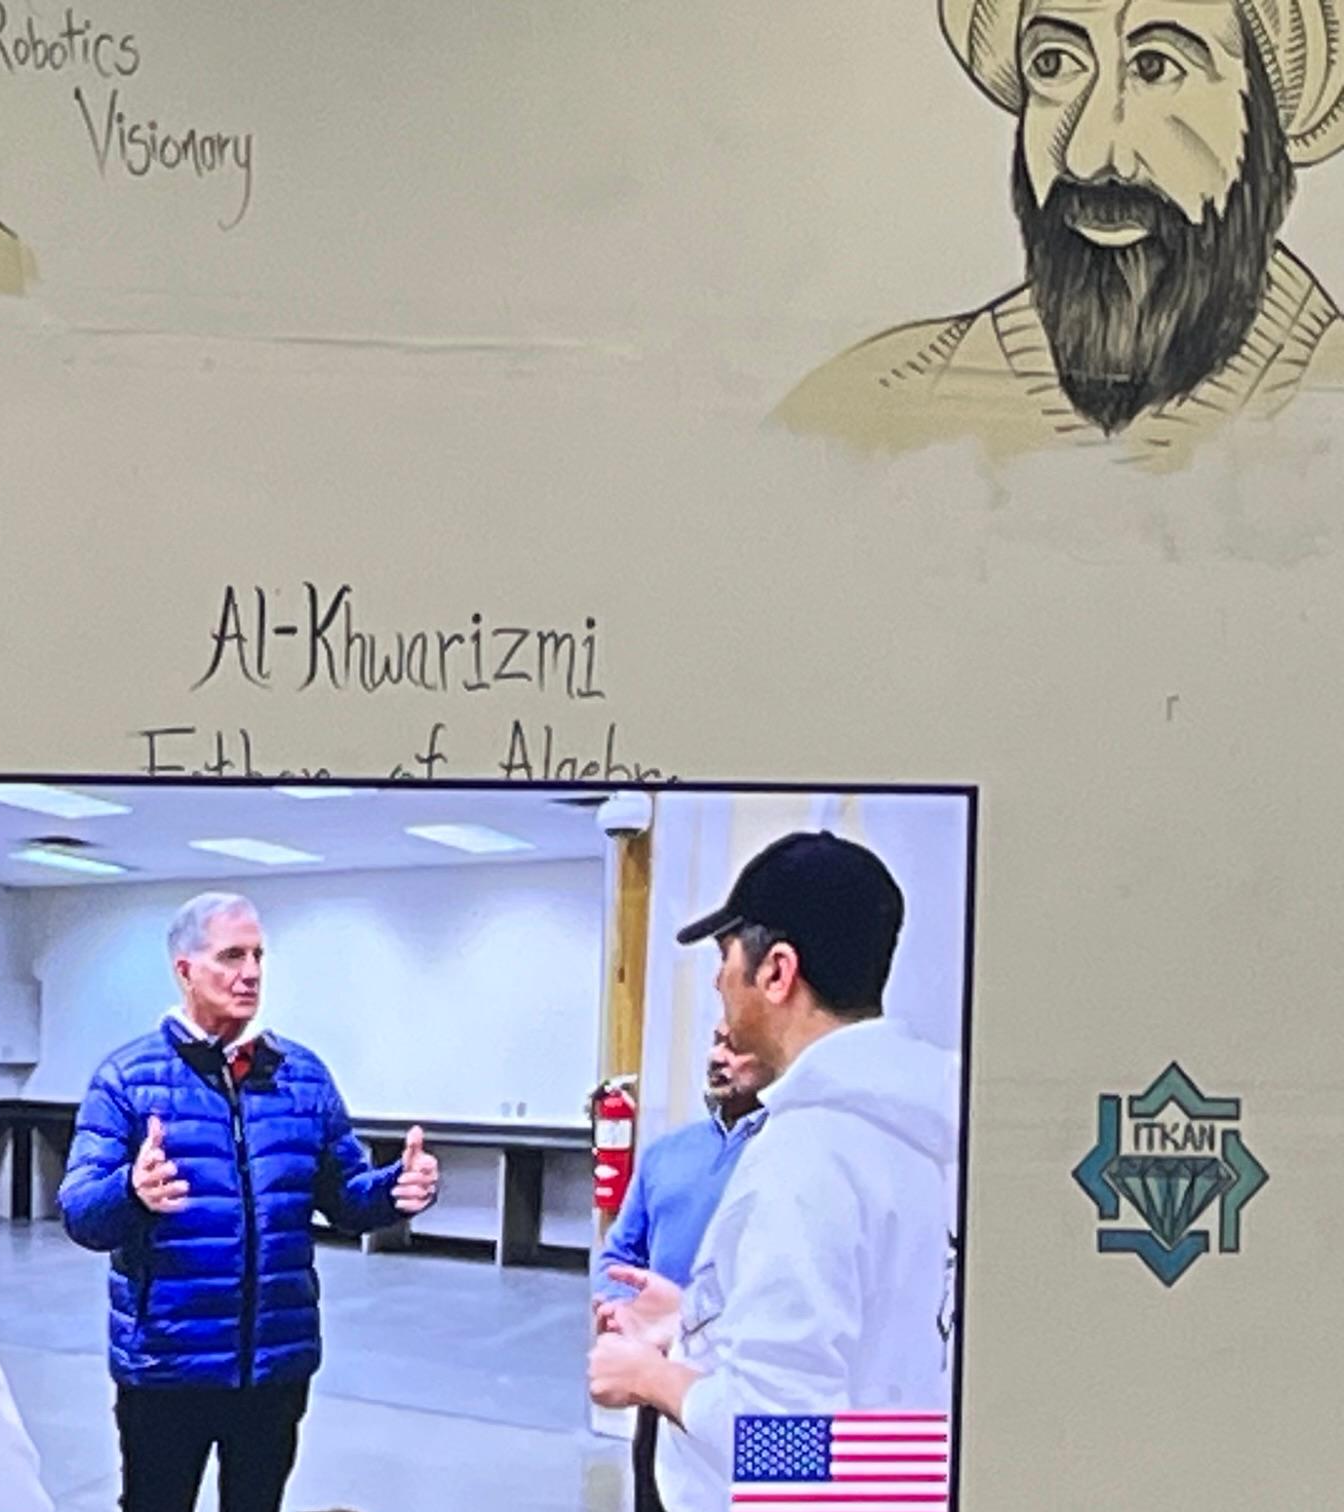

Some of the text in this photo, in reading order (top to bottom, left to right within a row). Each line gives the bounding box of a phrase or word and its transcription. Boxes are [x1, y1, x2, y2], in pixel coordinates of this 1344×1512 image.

[74, 86, 253, 232] Visionary
[189, 580, 606, 699] Al-Khwarizmi
[1132, 1121, 1216, 1152] ITKAN
